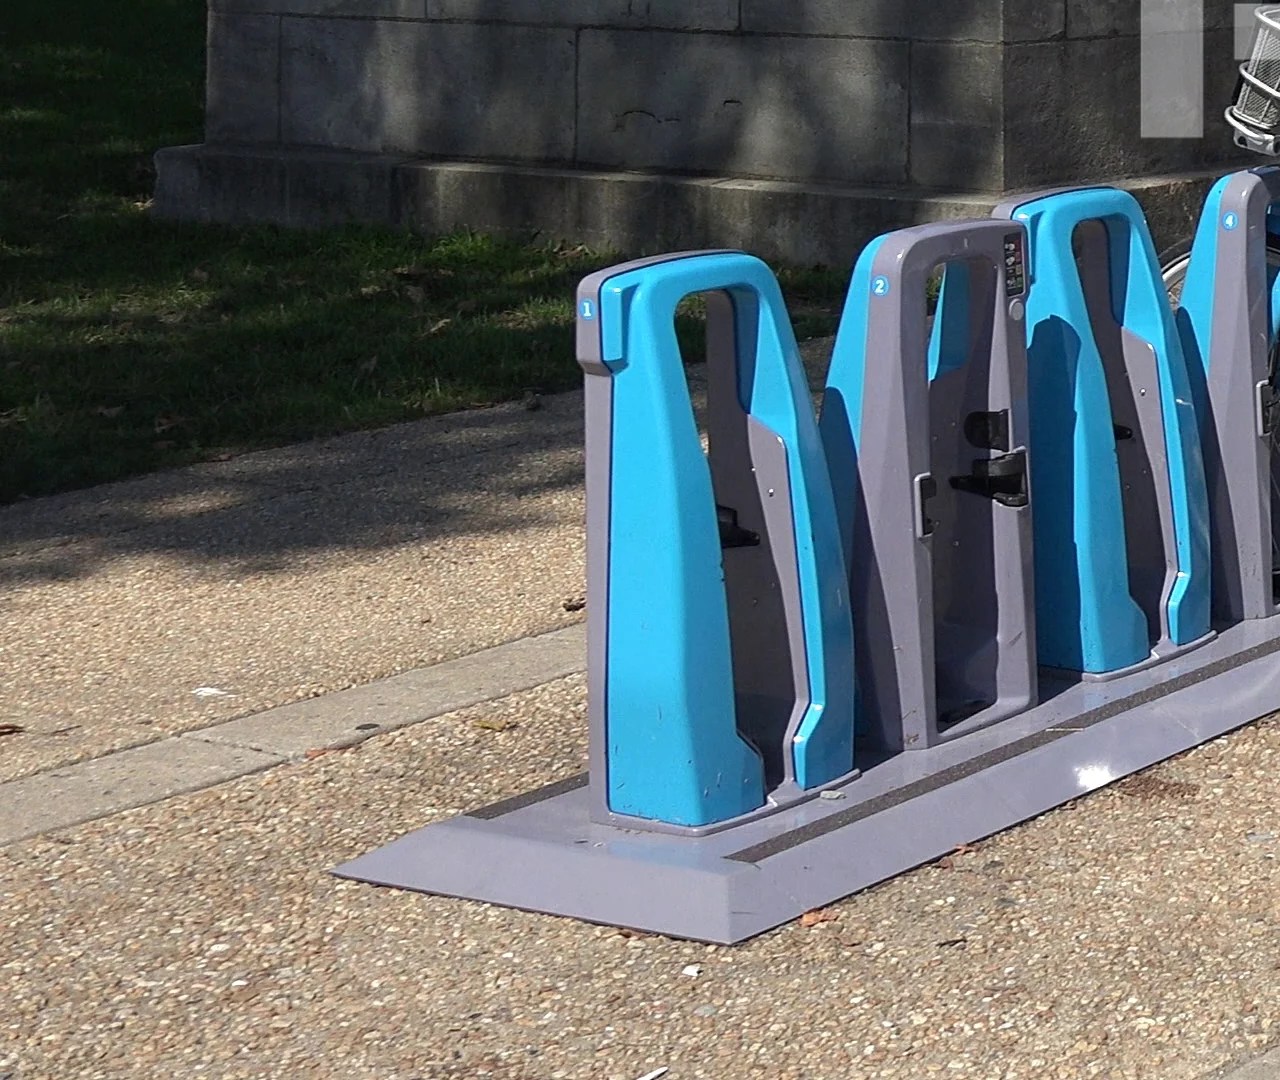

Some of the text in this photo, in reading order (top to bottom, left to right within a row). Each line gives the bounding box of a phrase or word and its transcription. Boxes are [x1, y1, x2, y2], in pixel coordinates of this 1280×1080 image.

[1225, 215, 1234, 227] 4
[875, 279, 885, 294] 2
[583, 302, 592, 317] 1
